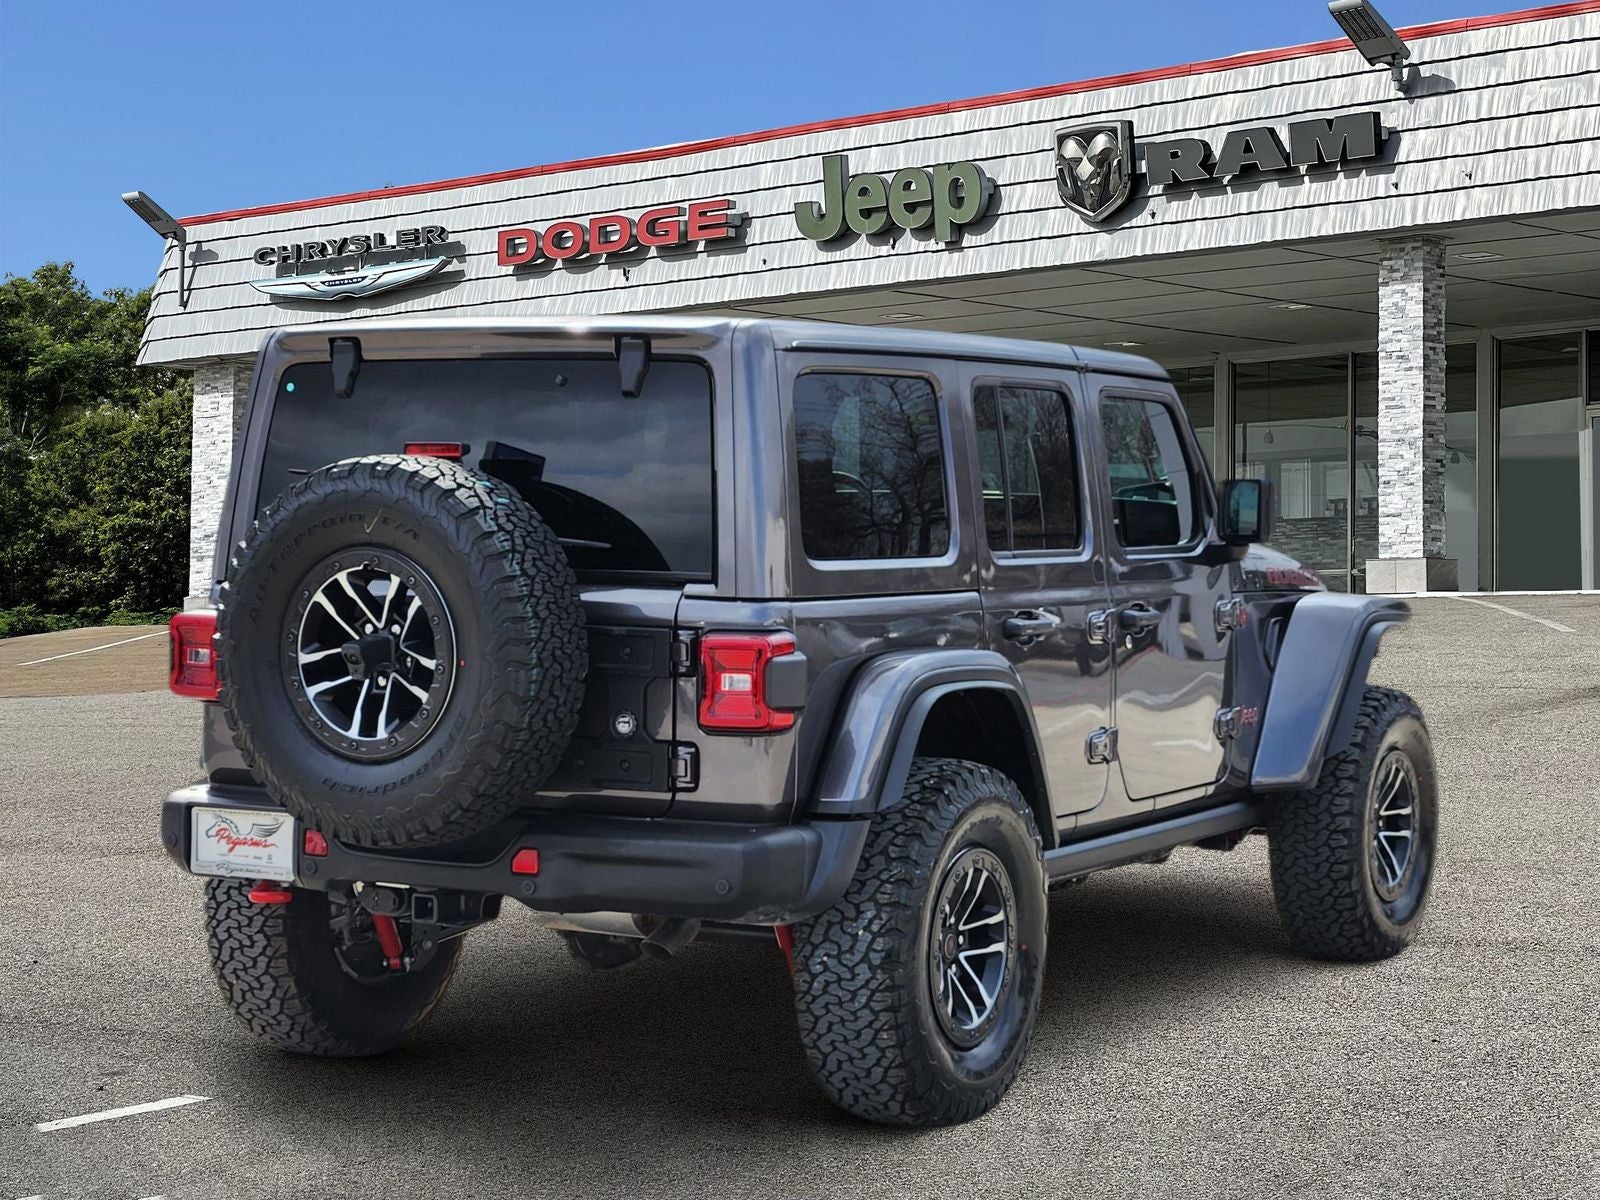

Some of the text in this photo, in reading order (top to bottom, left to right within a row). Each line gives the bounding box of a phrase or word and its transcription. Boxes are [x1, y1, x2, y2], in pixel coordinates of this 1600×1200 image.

[1146, 111, 1381, 186] RAM
[795, 154, 991, 242] Jeep
[253, 225, 449, 265] CHRYSLER
[498, 199, 737, 266] DODGE
[215, 827, 279, 853] Pegasus
